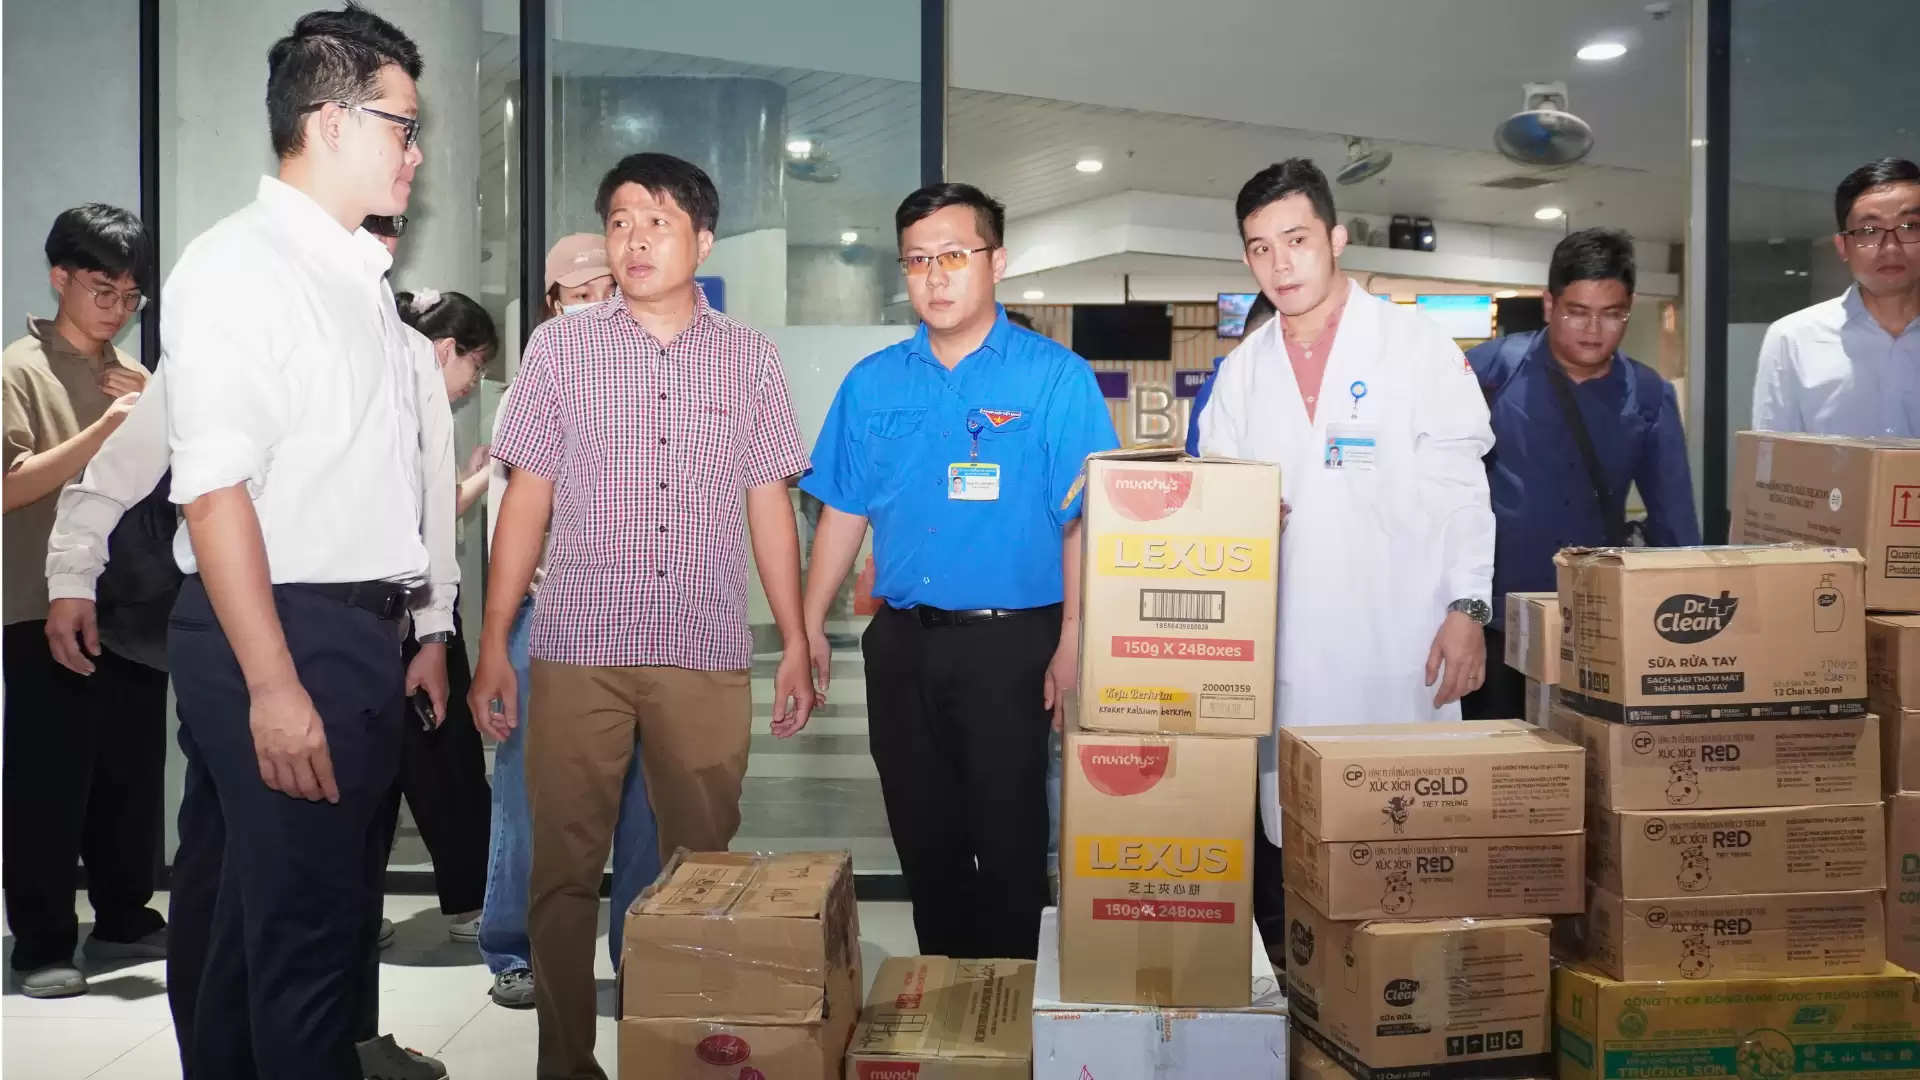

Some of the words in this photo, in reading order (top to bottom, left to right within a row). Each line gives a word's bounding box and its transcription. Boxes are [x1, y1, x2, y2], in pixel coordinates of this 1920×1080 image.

[1115, 477, 1179, 493] munchy's
[1114, 539, 1253, 576] LEXUS
[1656, 613, 1721, 632] Clean
[1124, 641, 1159, 656] 150g
[1178, 643, 1242, 657] 24Boxes
[1648, 655, 1676, 668] SỮA
[1680, 654, 1708, 668] RỬA
[1712, 656, 1738, 666] TAY
[1202, 683, 1251, 693] 200001359
[1786, 687, 1806, 696] Chai
[1635, 738, 1652, 747] CP
[1678, 745, 1696, 758] XÍCH
[1345, 771, 1363, 781] CP
[1369, 778, 1389, 792] XÚC
[1391, 777, 1411, 791] XÍCH
[1647, 825, 1664, 834] CP
[1689, 831, 1707, 845] XÍCH
[1091, 839, 1228, 878] LEXUS
[1353, 849, 1369, 859] CP
[1375, 857, 1392, 870] XÚC
[1394, 857, 1411, 870] XÍCH
[1128, 882, 1201, 896] 芝士夾心餅
[1106, 904, 1140, 919] 150g
[1159, 906, 1222, 919] 24Boxes
